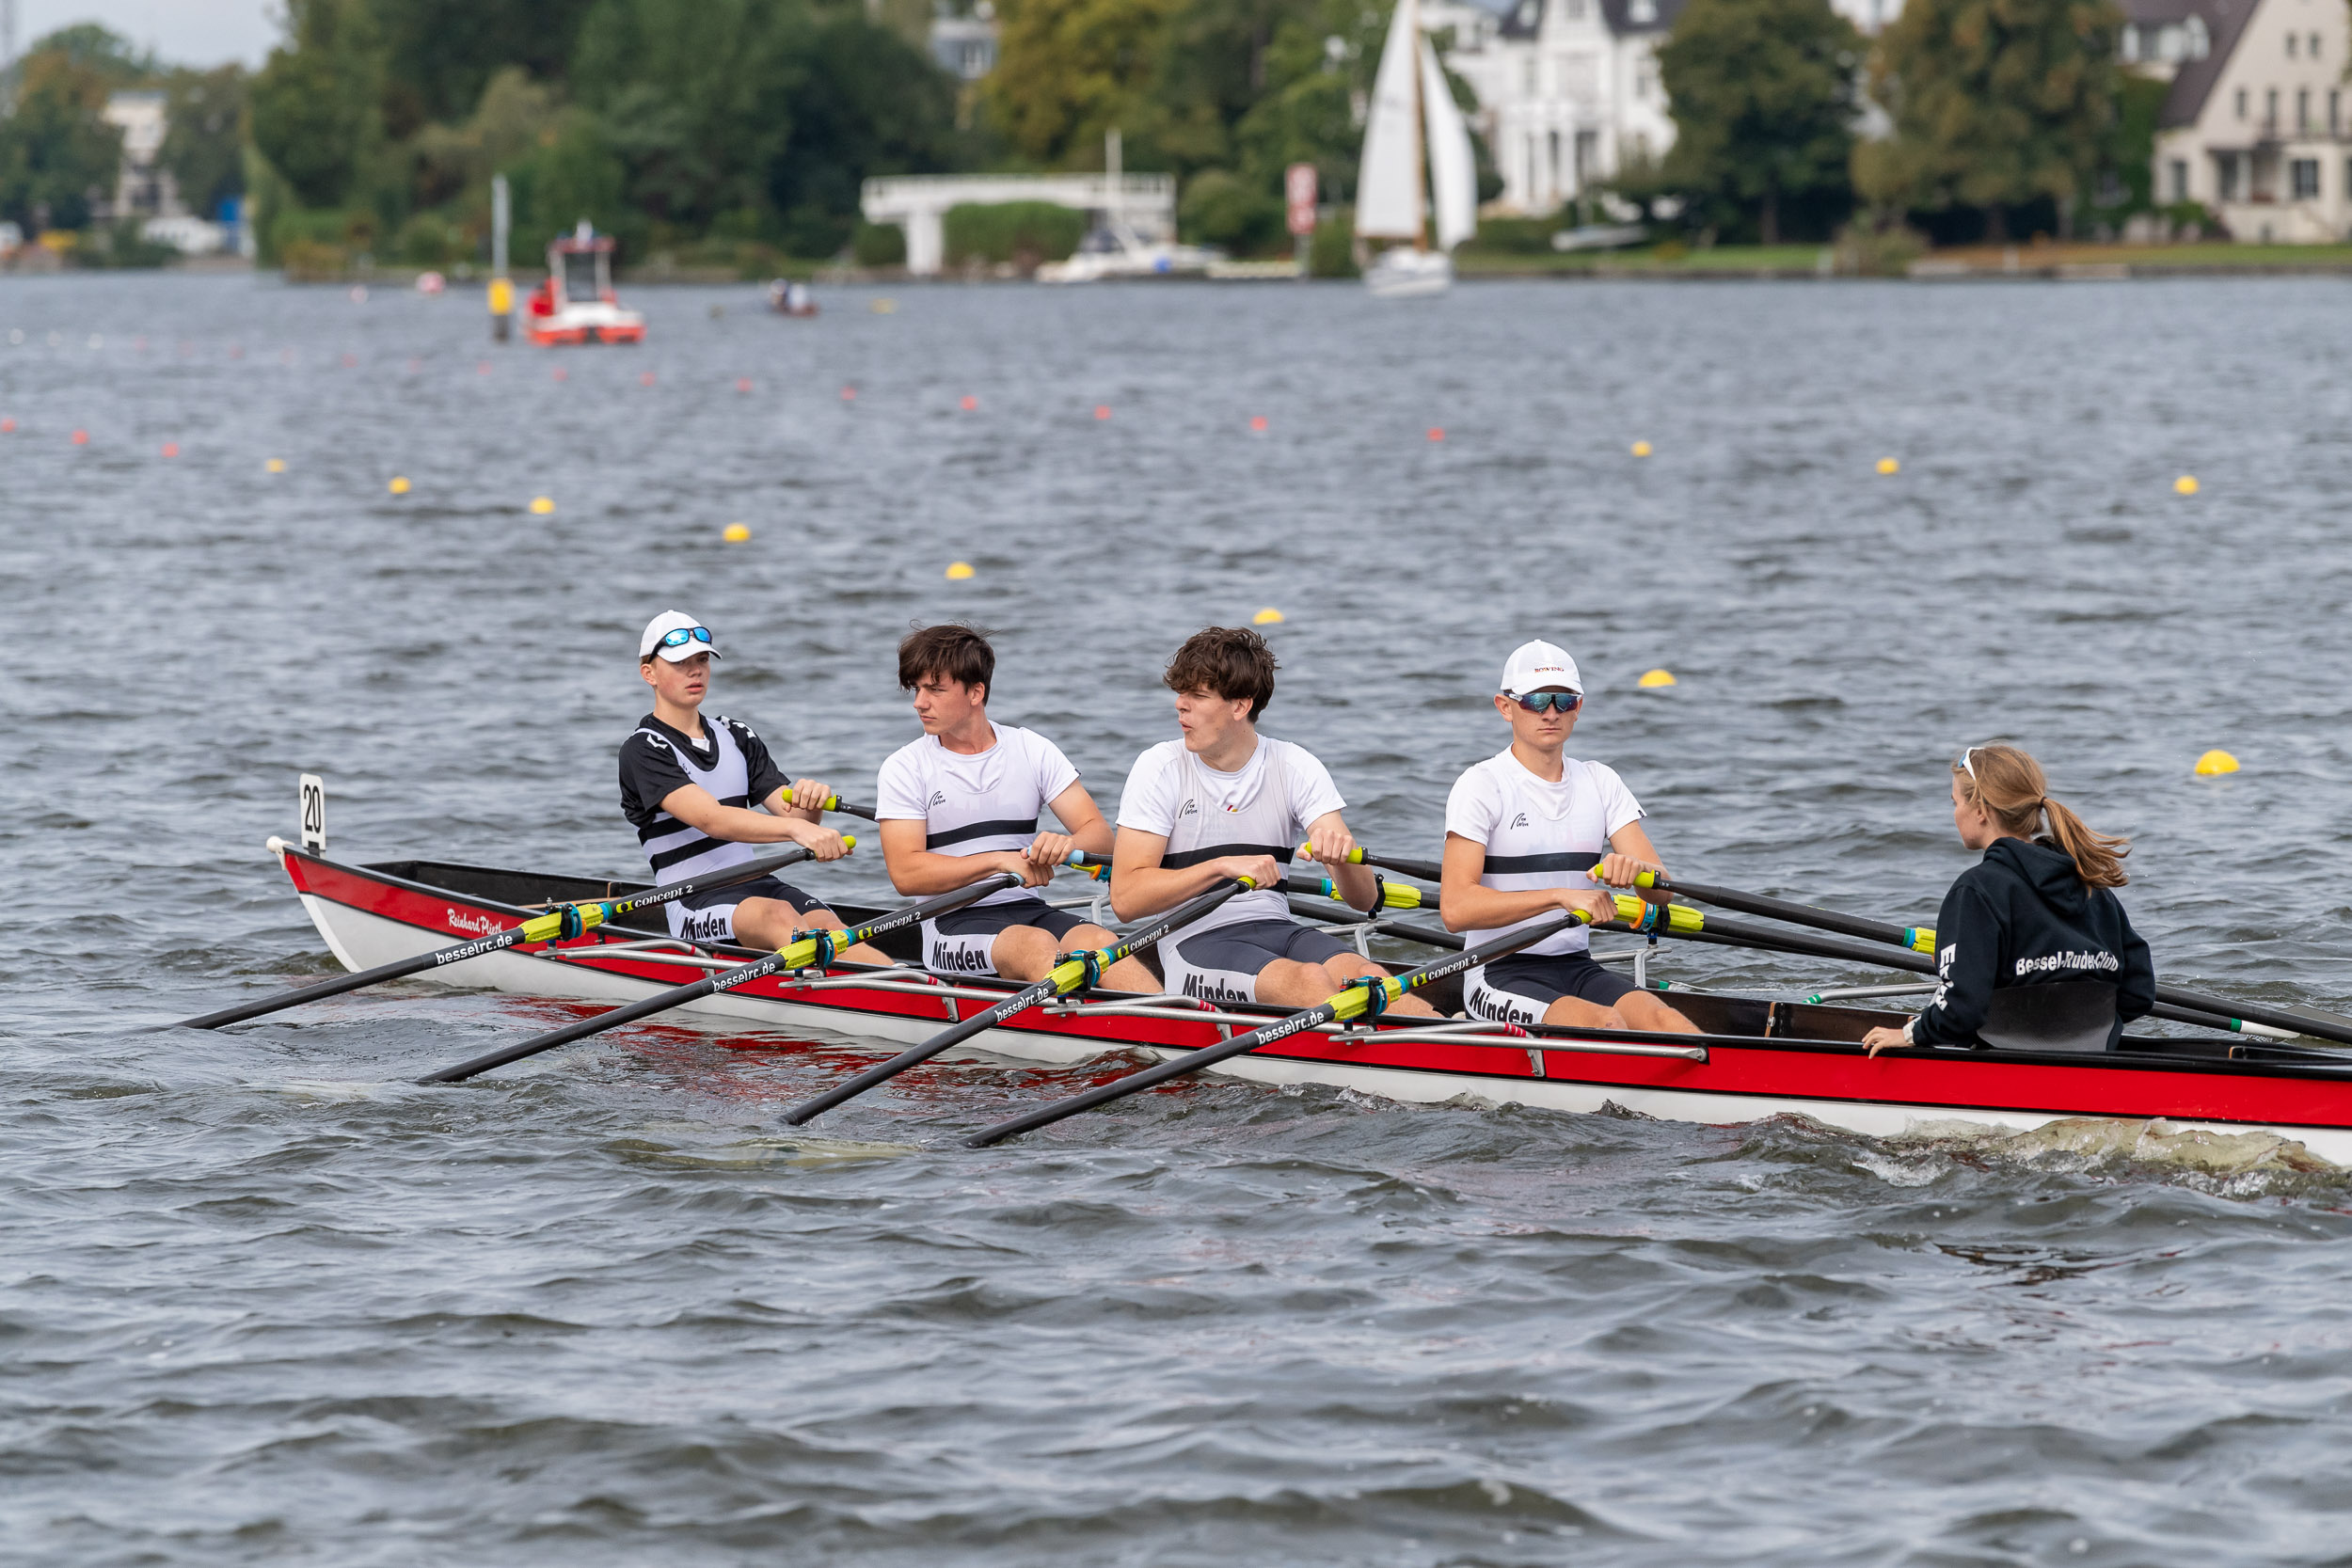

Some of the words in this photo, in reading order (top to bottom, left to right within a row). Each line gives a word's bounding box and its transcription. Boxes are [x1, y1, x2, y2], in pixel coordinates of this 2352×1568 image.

[304, 784, 322, 834] 20
[634, 887, 684, 909] concept
[686, 884, 694, 895] 2
[679, 911, 728, 941] Minden
[873, 913, 913, 934] concept
[914, 911, 921, 921] 2
[1129, 927, 1163, 952] concept
[1164, 924, 1169, 934] 2
[435, 934, 514, 965] besselrc.de
[931, 941, 989, 972] Minden
[711, 961, 777, 992] besselrc.de
[1428, 957, 1470, 981] concept
[1470, 954, 1479, 964] 2
[993, 987, 1050, 1022] besselrc.de
[1469, 986, 1534, 1024] Minden
[1255, 1011, 1325, 1045] besselrc.de
